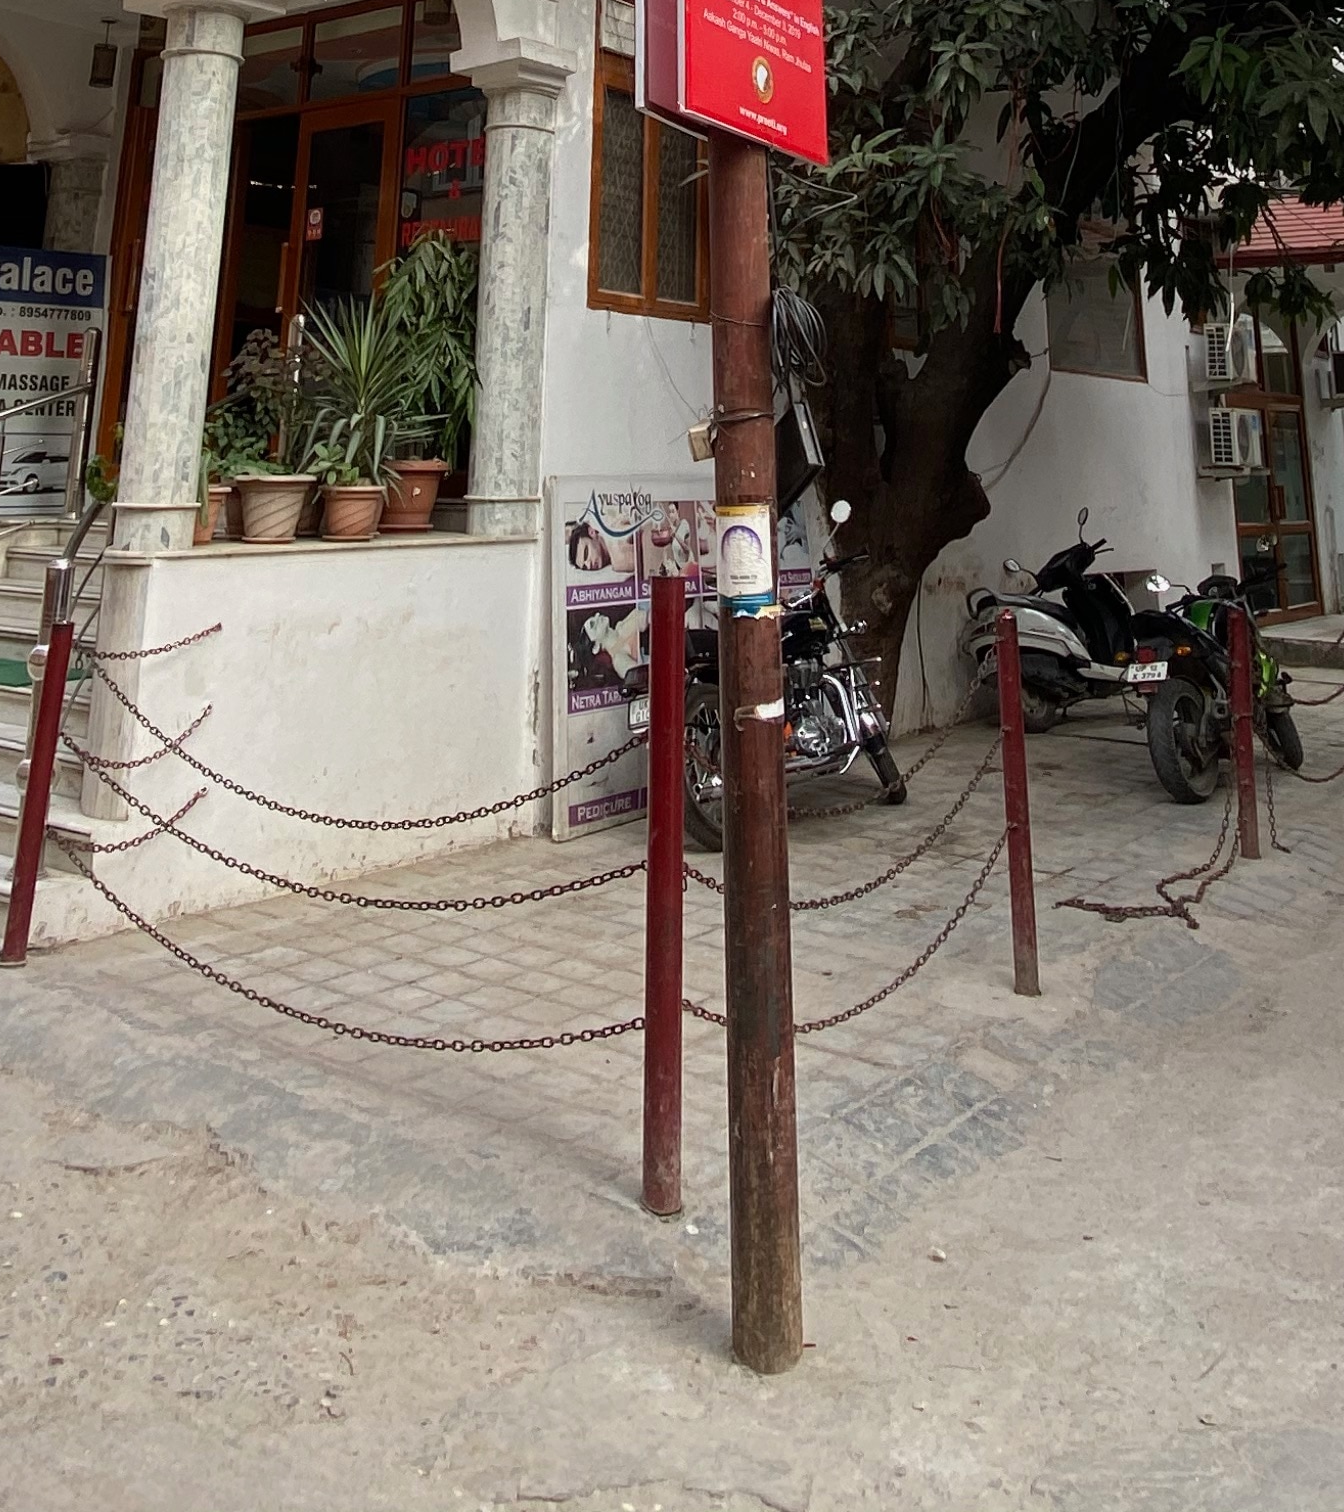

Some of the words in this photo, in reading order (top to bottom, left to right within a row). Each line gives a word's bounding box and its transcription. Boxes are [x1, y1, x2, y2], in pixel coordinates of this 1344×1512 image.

[406, 138, 485, 175] HOTE
[570, 586, 632, 603] ABHIYANGAM
[571, 695, 601, 711] NETRA
[577, 796, 632, 822] PEDICURE
